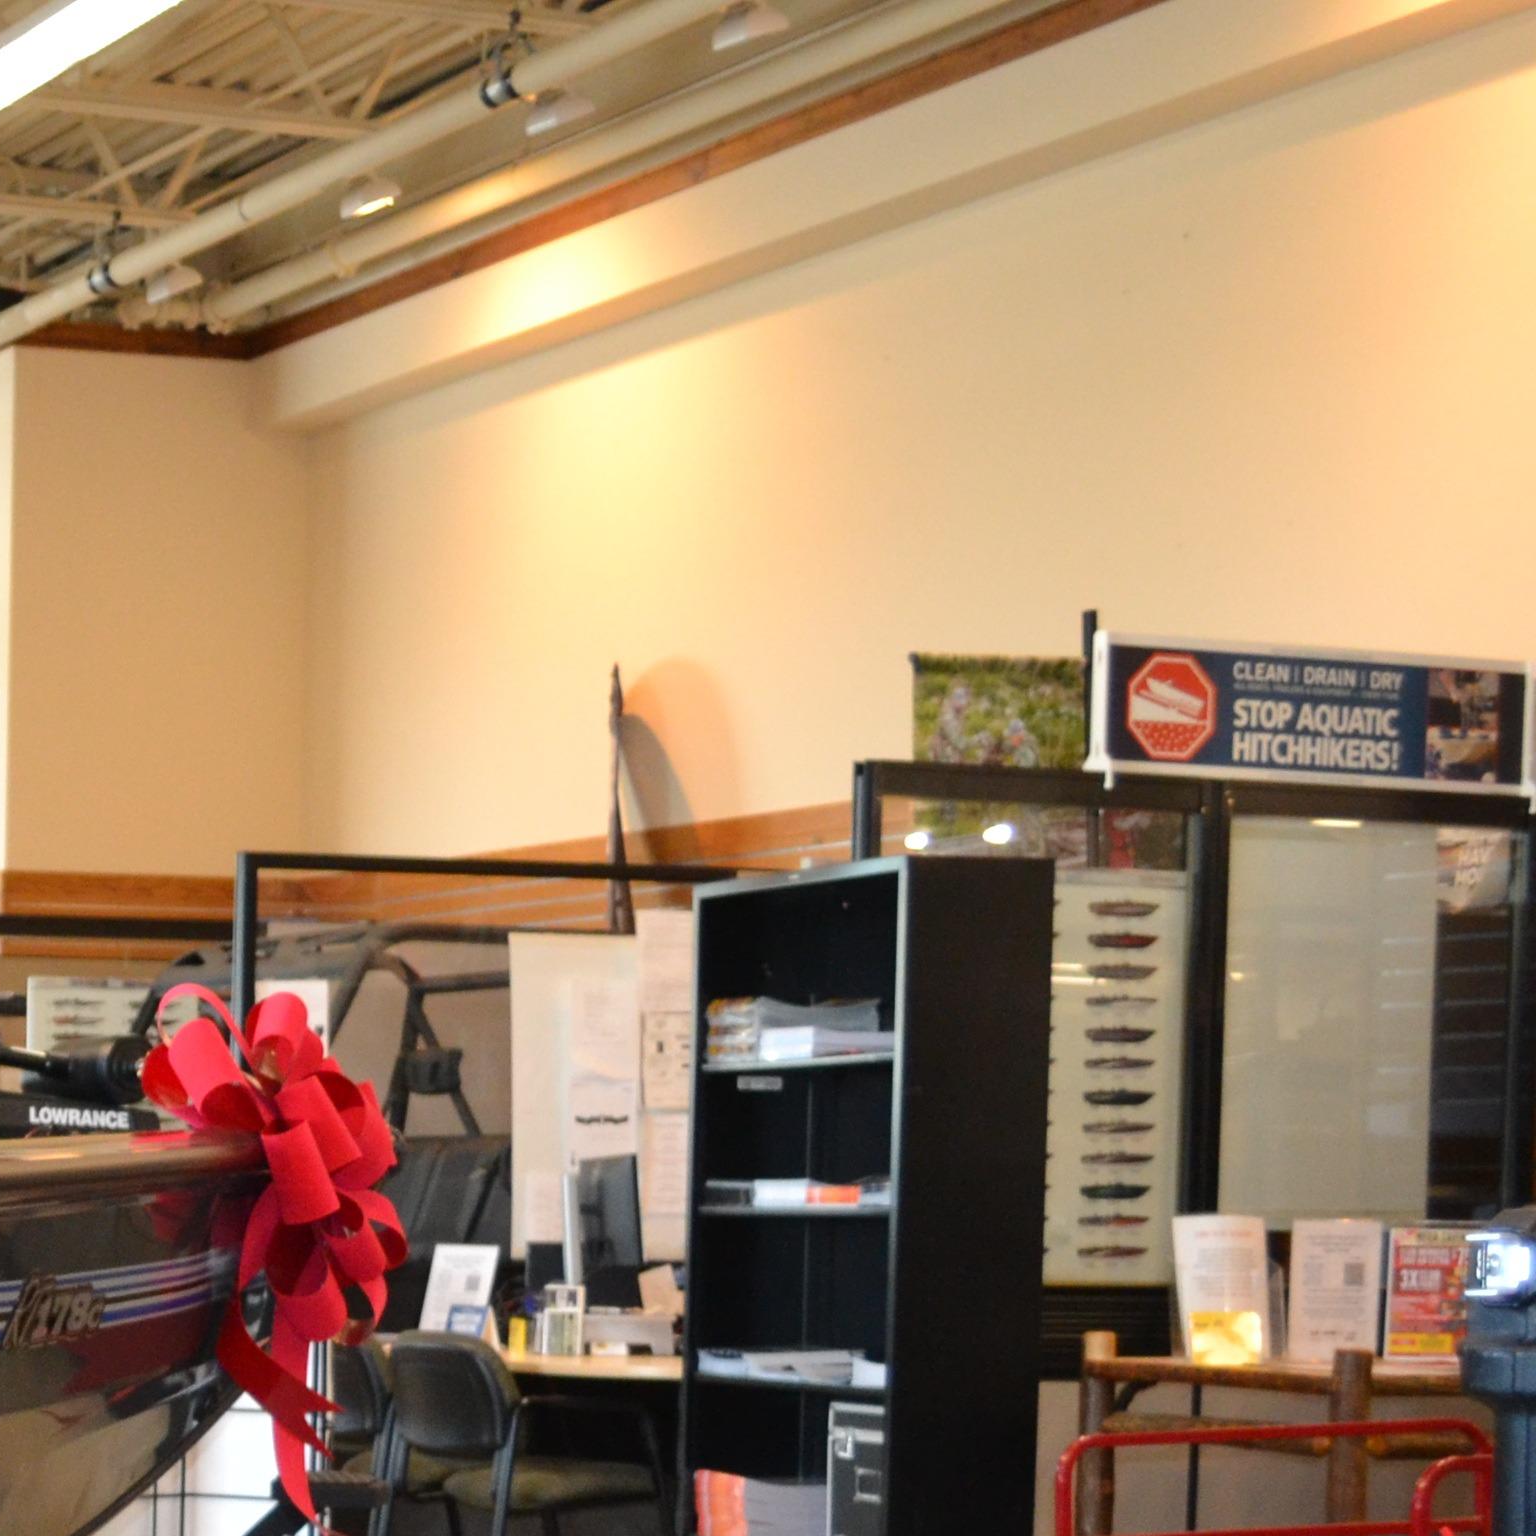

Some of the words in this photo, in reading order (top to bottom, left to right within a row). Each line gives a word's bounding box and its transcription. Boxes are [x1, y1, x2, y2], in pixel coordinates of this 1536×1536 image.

[1232, 660, 1290, 683] CLEAN
[1303, 665, 1357, 688] DRAIN
[1369, 670, 1404, 690] DRY
[1232, 698, 1295, 730] STOP
[1296, 702, 1401, 738] AQUATIC
[1232, 731, 1401, 772] HITCHHIKERS!
[28, 1105, 131, 1130] LOWRANCE
